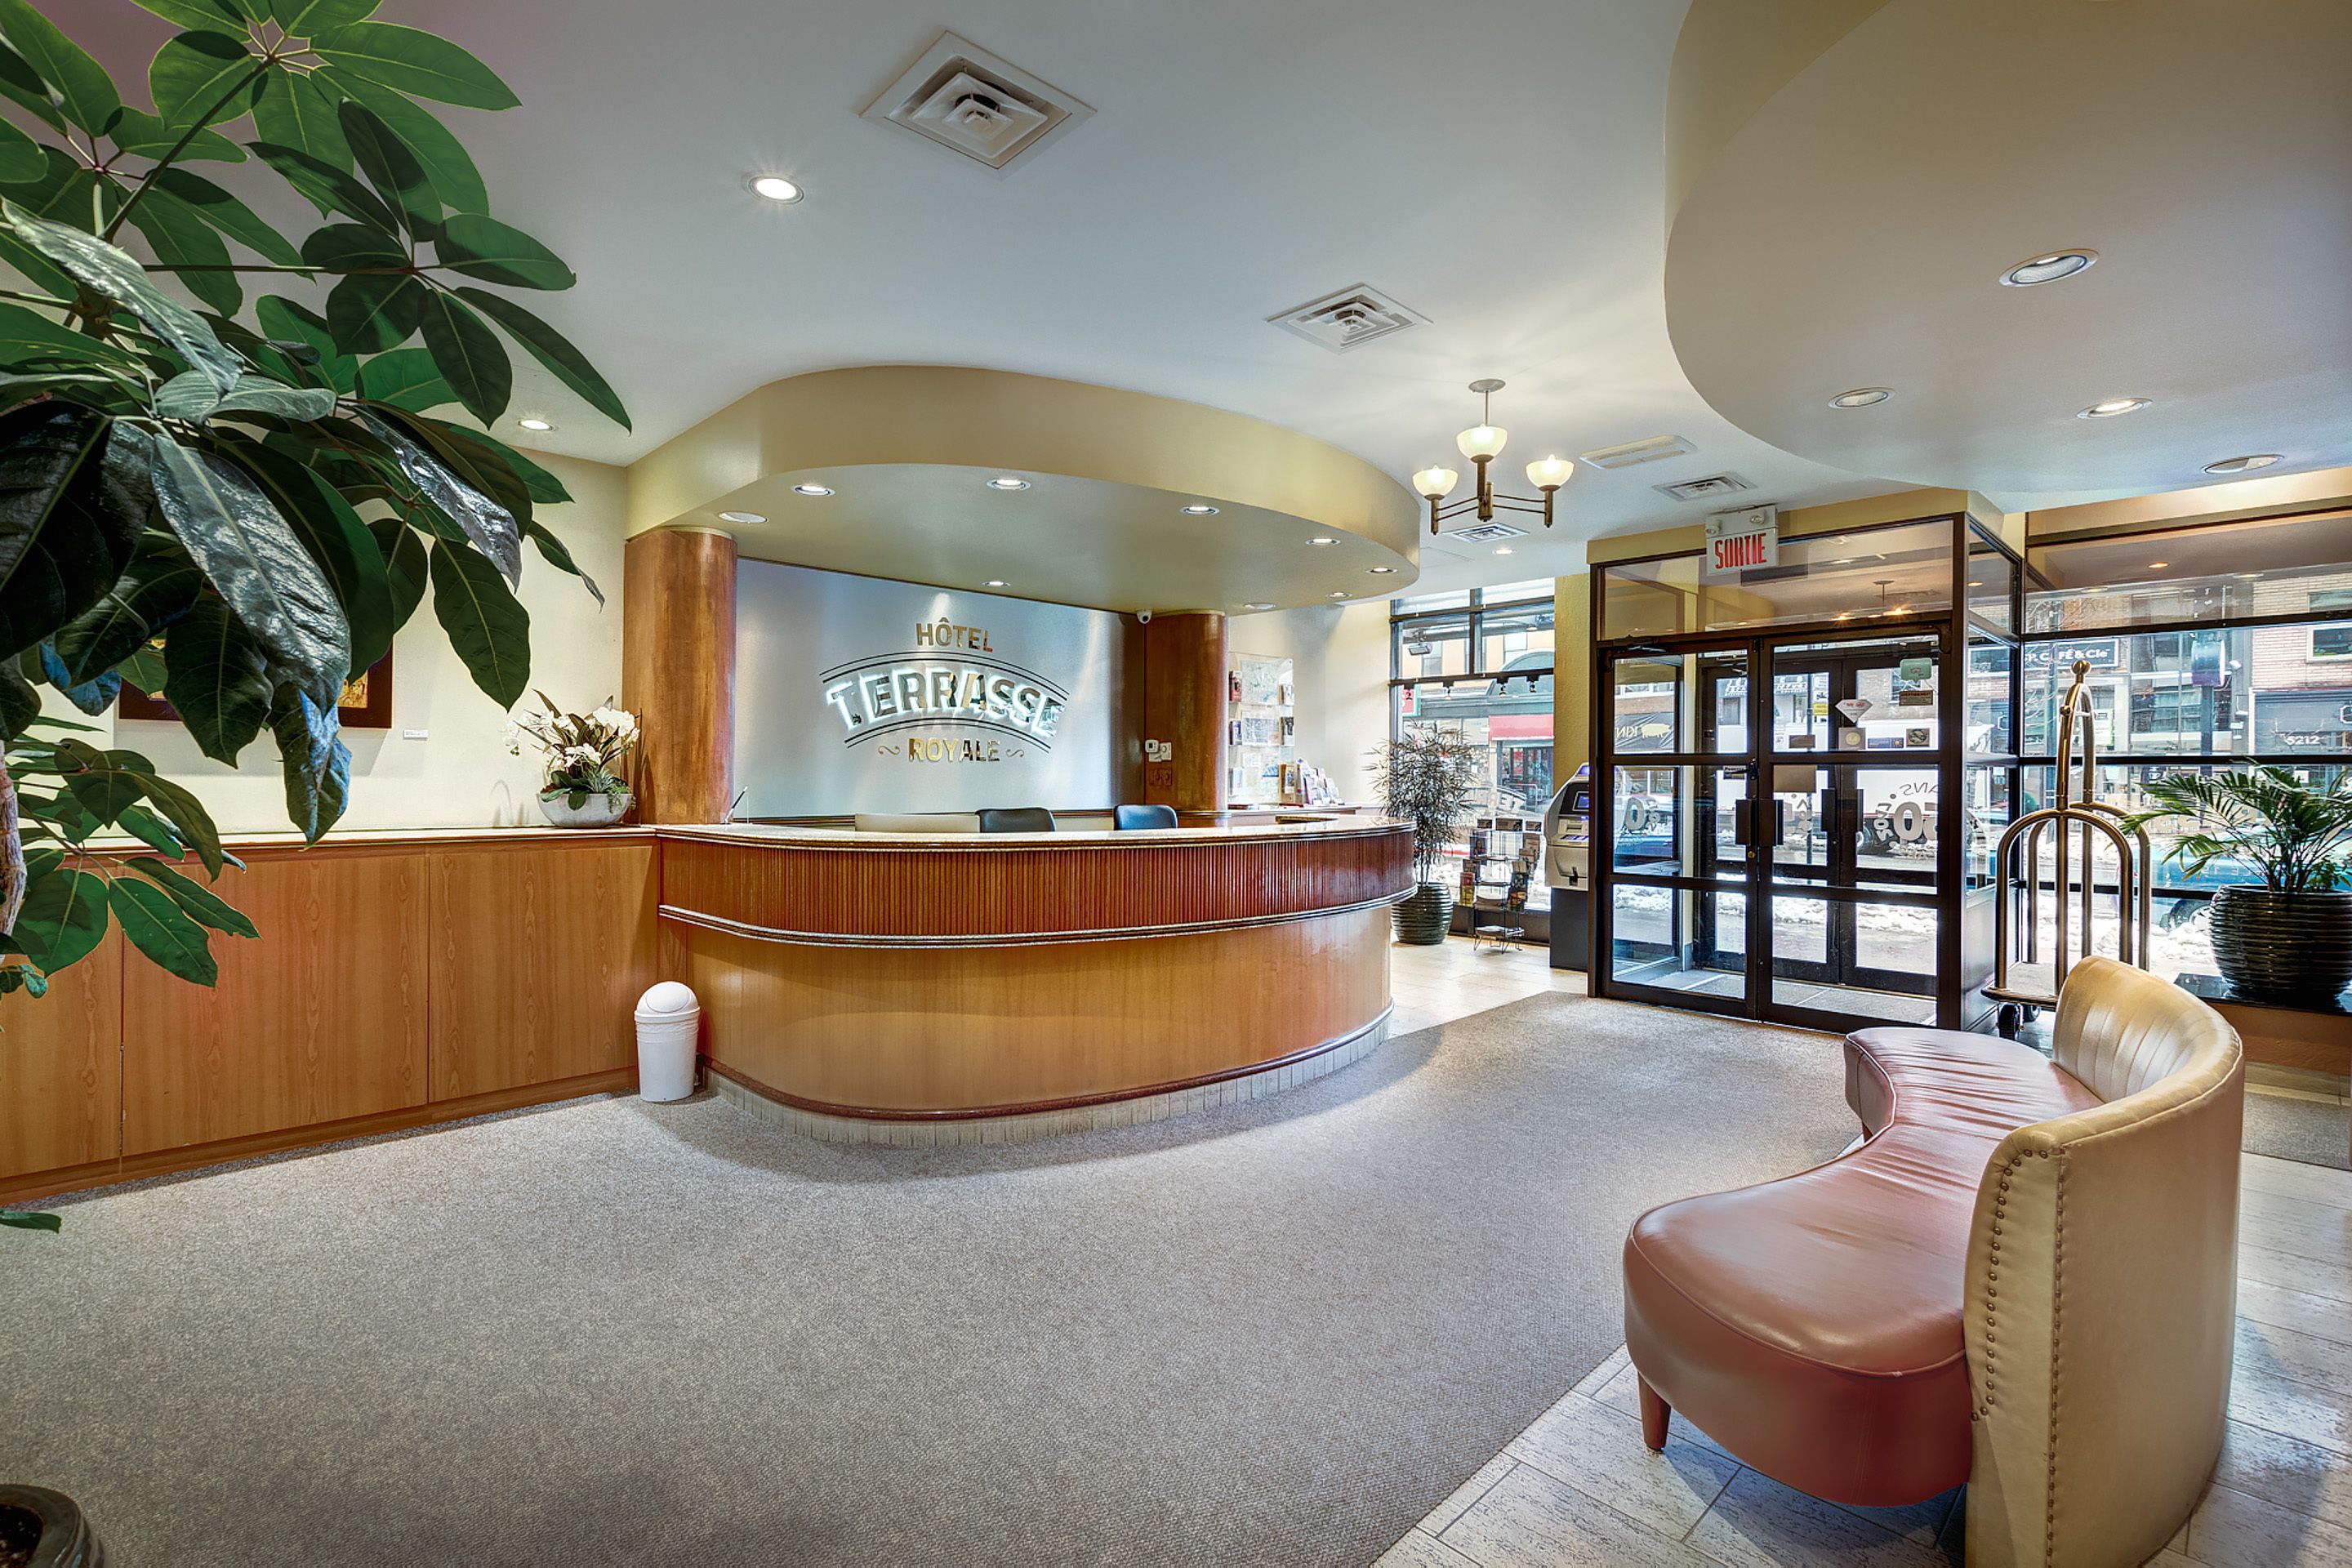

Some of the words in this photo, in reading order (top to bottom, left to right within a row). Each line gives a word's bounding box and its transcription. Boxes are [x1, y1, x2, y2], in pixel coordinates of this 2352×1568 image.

[1715, 532, 1767, 569] SORTIE
[915, 617, 993, 653] HÔTEL
[825, 667, 1066, 737] TERRASSE
[908, 737, 1001, 763] ROYALE
[2285, 735, 2321, 746] 5212
